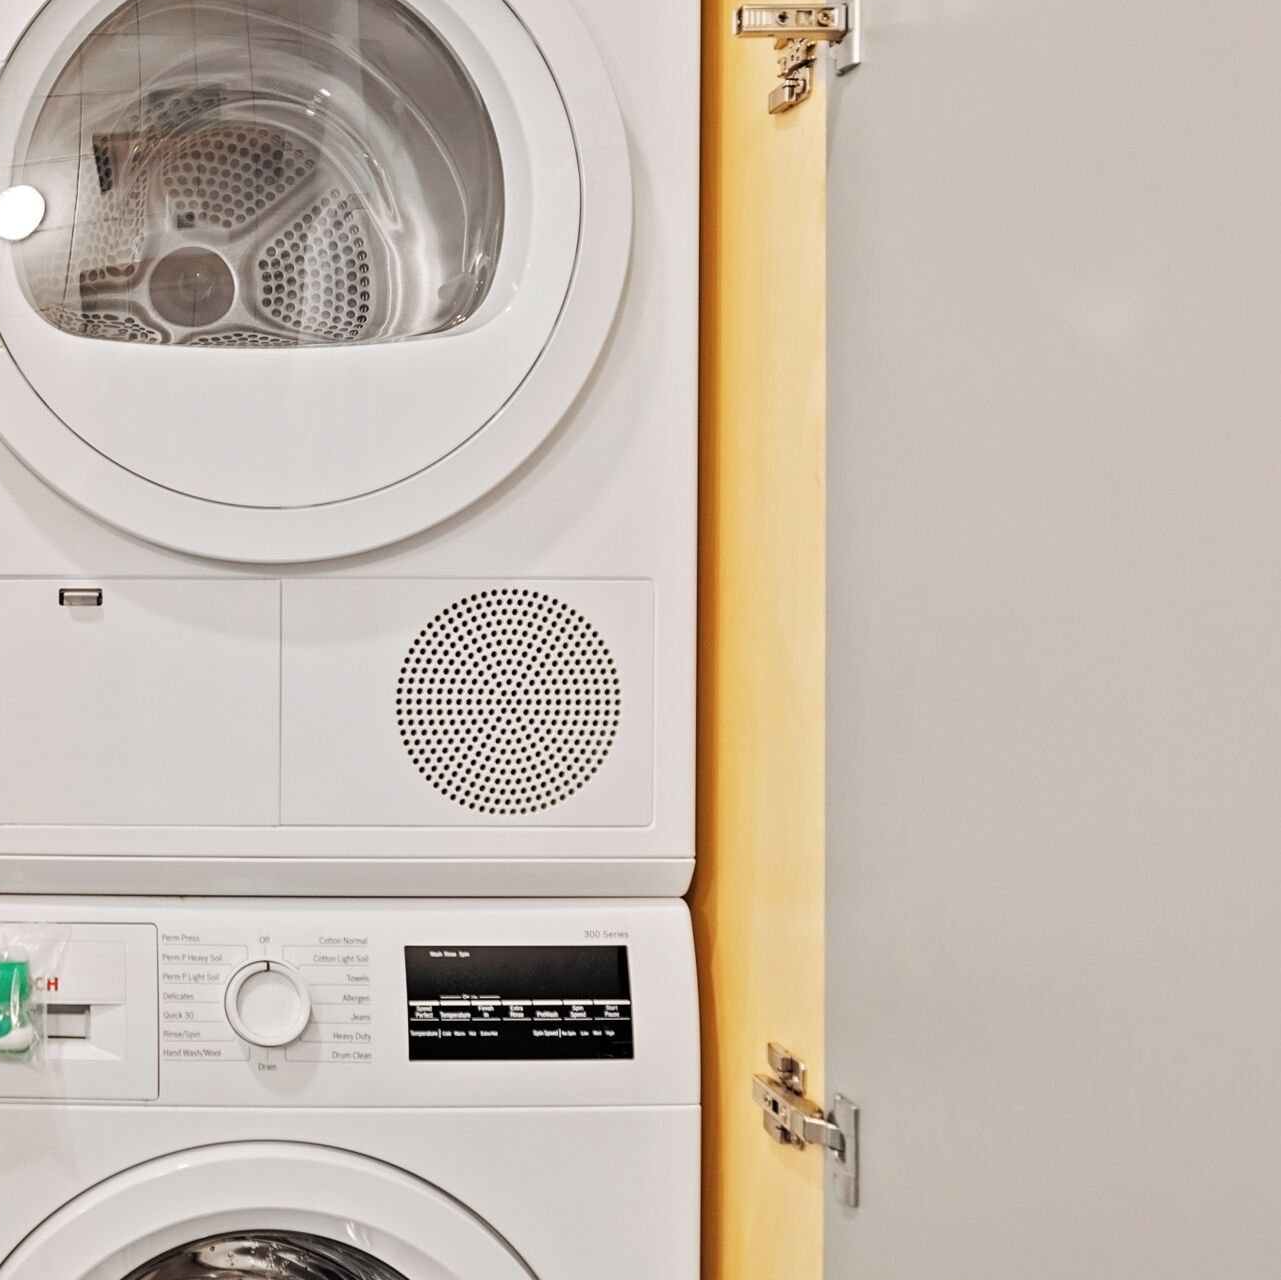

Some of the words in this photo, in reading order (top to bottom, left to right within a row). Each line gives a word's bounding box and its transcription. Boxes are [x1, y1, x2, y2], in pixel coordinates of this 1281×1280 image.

[259, 936, 270, 944] Off
[188, 954, 208, 963] Heavy
[338, 955, 353, 964] Light
[163, 973, 180, 981] Perm
[182, 973, 187, 981] P
[188, 973, 205, 982] Light
[207, 973, 219, 981] Soil
[343, 995, 370, 1003] Allergen
[163, 1012, 182, 1020] Quick
[440, 1011, 471, 1019] Temperature
[164, 1031, 201, 1040] Rinse/Spin
[333, 1032, 353, 1042] Heavy
[356, 1033, 371, 1042] Duty
[163, 1049, 181, 1057] Hand
[183, 1049, 221, 1057] Wash/Wool
[354, 1052, 372, 1060] Clean
[258, 1063, 276, 1071] Drain
